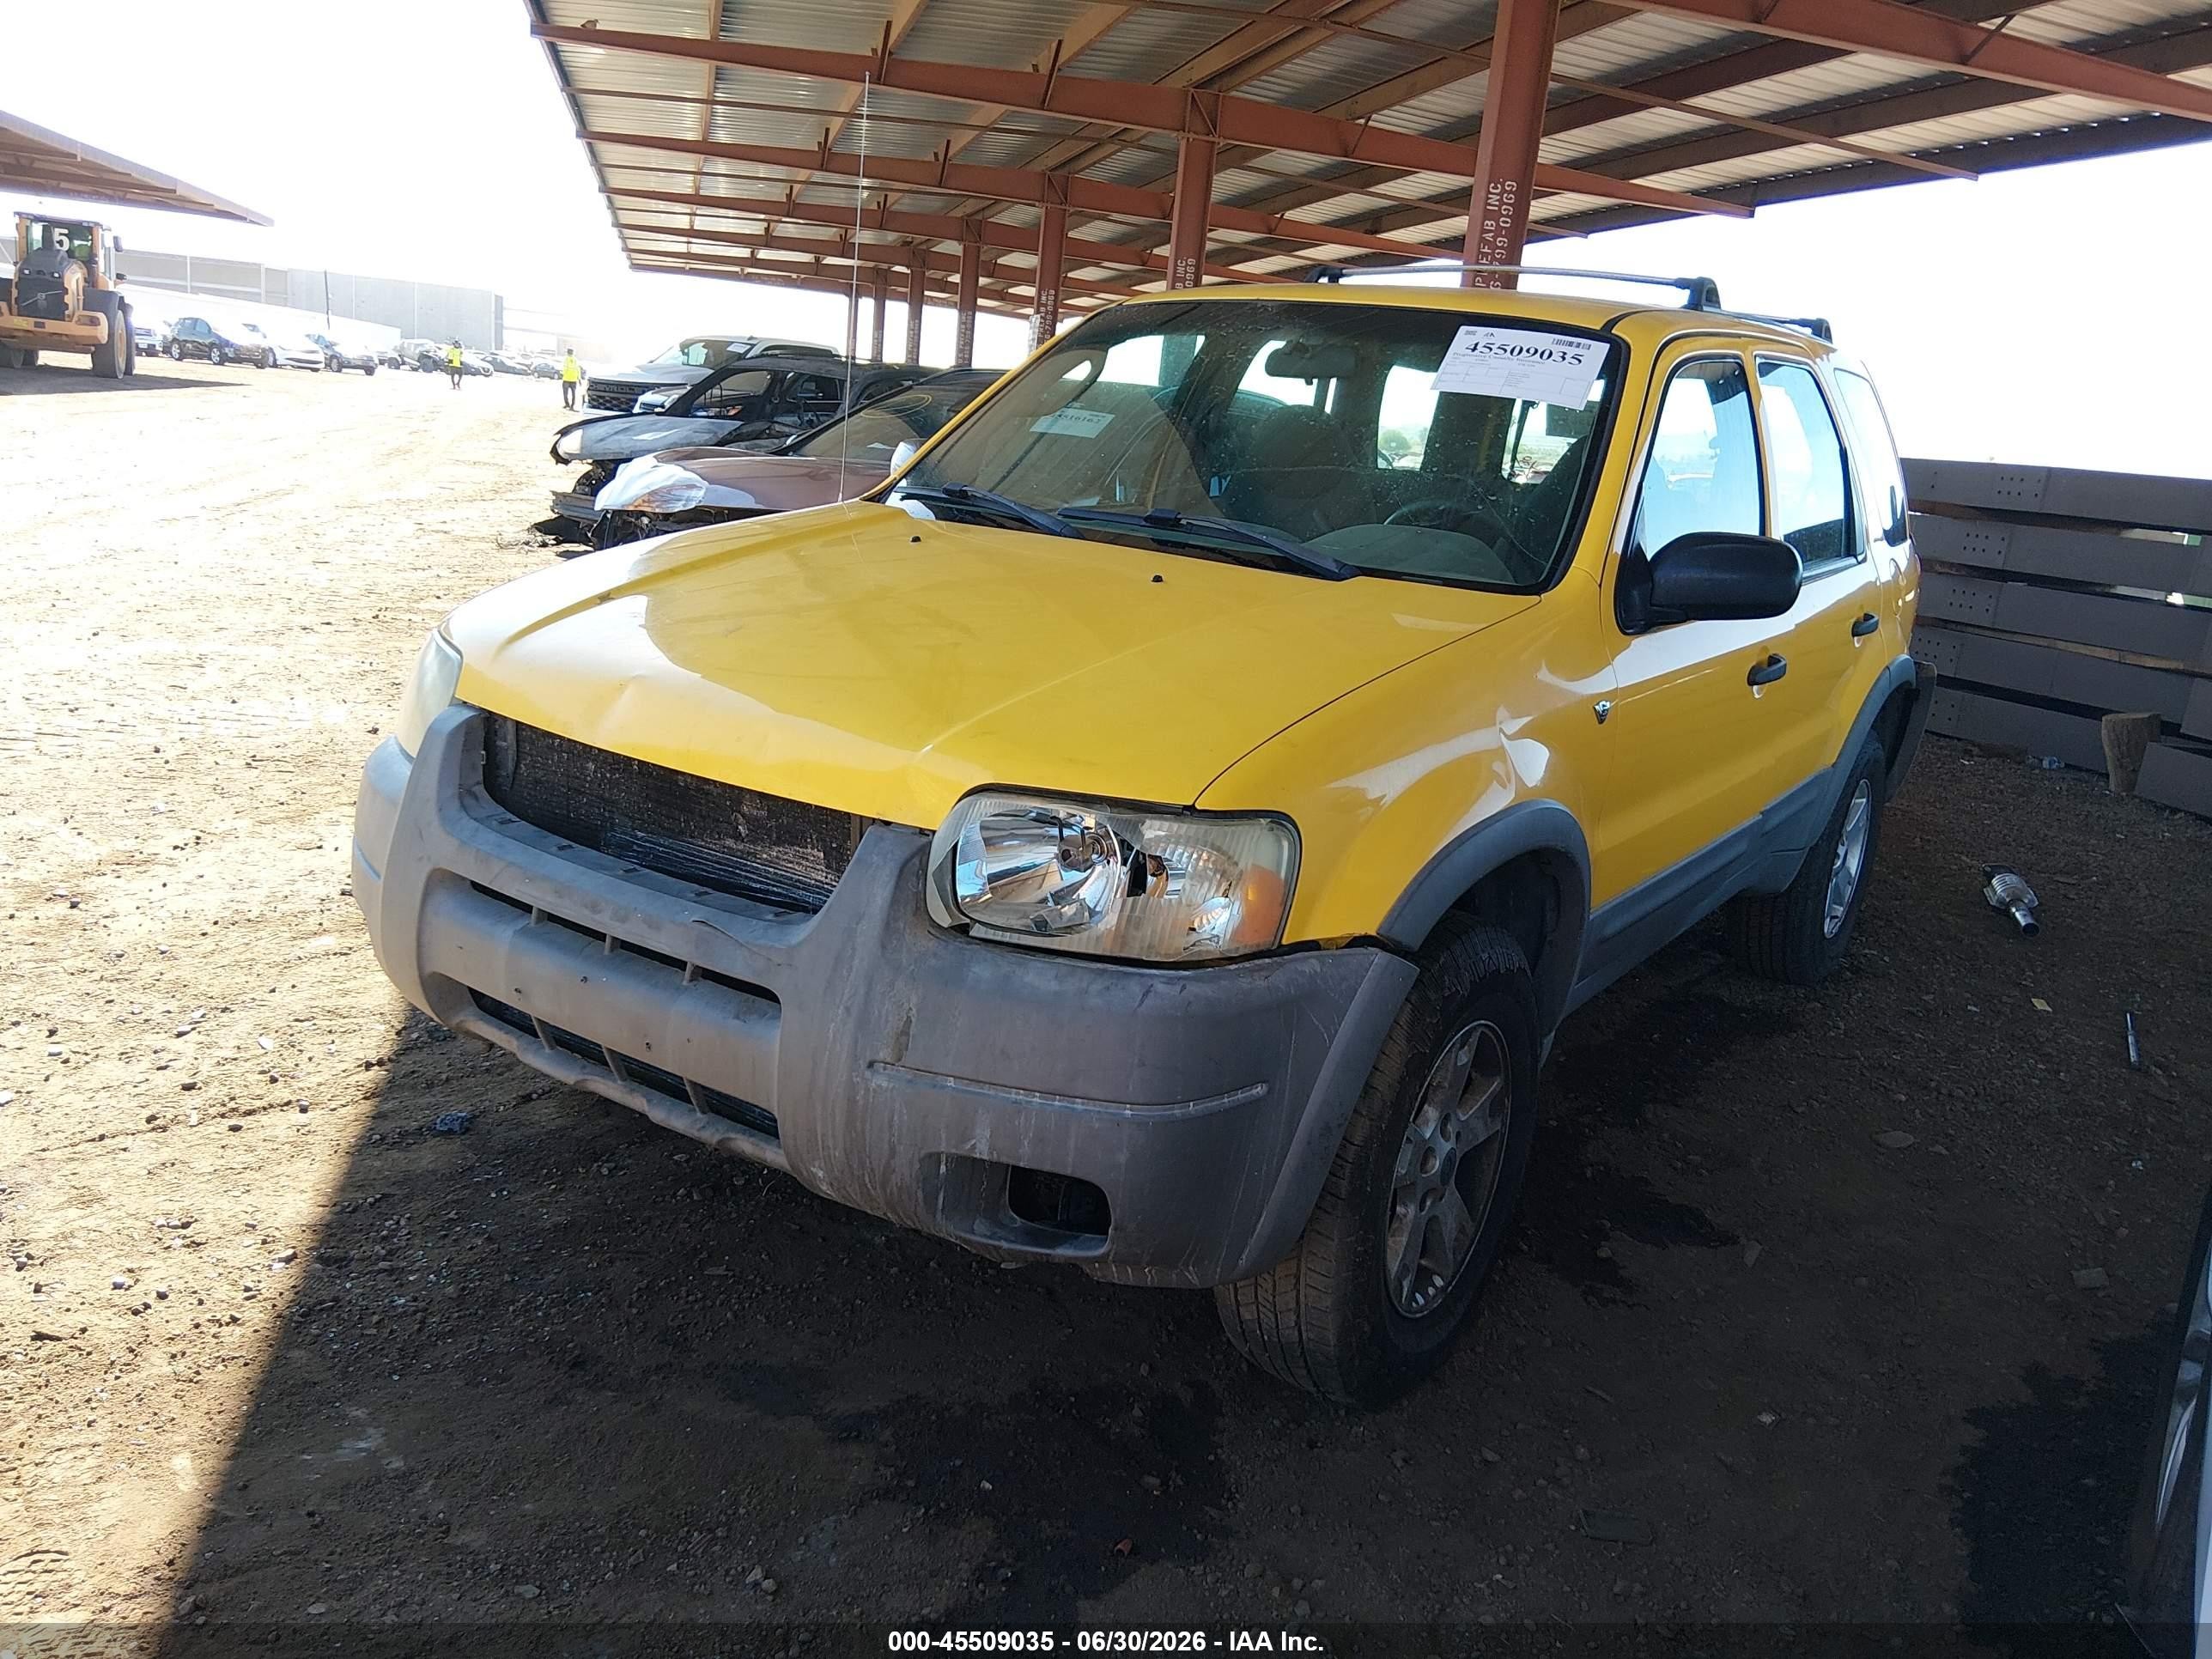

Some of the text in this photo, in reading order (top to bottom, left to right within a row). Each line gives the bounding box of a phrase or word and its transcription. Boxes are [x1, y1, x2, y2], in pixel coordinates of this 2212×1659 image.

[1486, 178, 1504, 210] INC.
[53, 228, 70, 252] 5
[1176, 257, 1188, 277] INC.
[1464, 341, 1585, 366] 45509035
